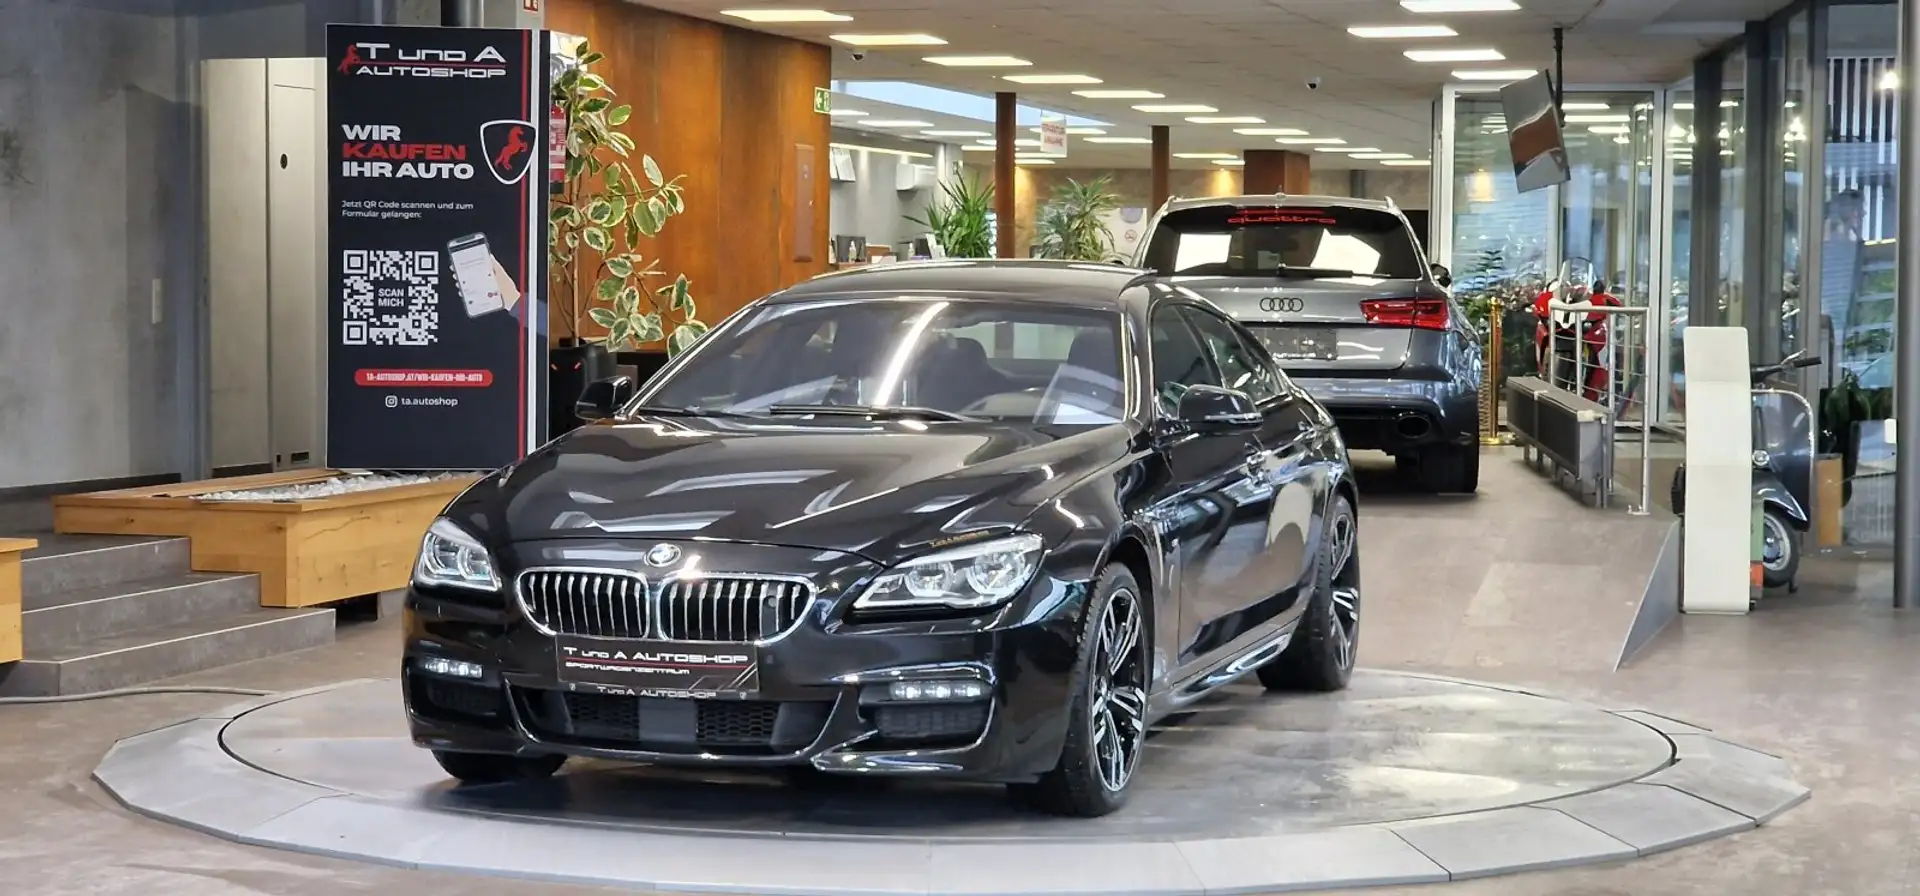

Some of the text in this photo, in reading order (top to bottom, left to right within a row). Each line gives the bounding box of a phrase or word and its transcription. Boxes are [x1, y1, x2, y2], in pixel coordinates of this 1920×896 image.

[356, 43, 390, 59] T
[473, 46, 506, 62] A
[356, 66, 506, 78] AUTOSHOP
[342, 124, 401, 141] WIR
[342, 143, 466, 160] KAUFEN
[342, 161, 474, 179] IHR AUTO
[342, 200, 362, 208] Jetzt
[363, 200, 377, 209] QR
[378, 200, 400, 209] Code
[401, 201, 436, 209] scannen
[437, 201, 454, 210] und
[342, 209, 422, 220] Formular gelangen:
[1228, 215, 1336, 224] quattro
[378, 287, 404, 297] SCAN
[378, 298, 404, 307] MICH
[401, 397, 459, 407] ta.autoshop
[563, 647, 577, 656] T
[633, 652, 748, 664] AUTOSHOP
[640, 689, 717, 699] AUTOSHOP
